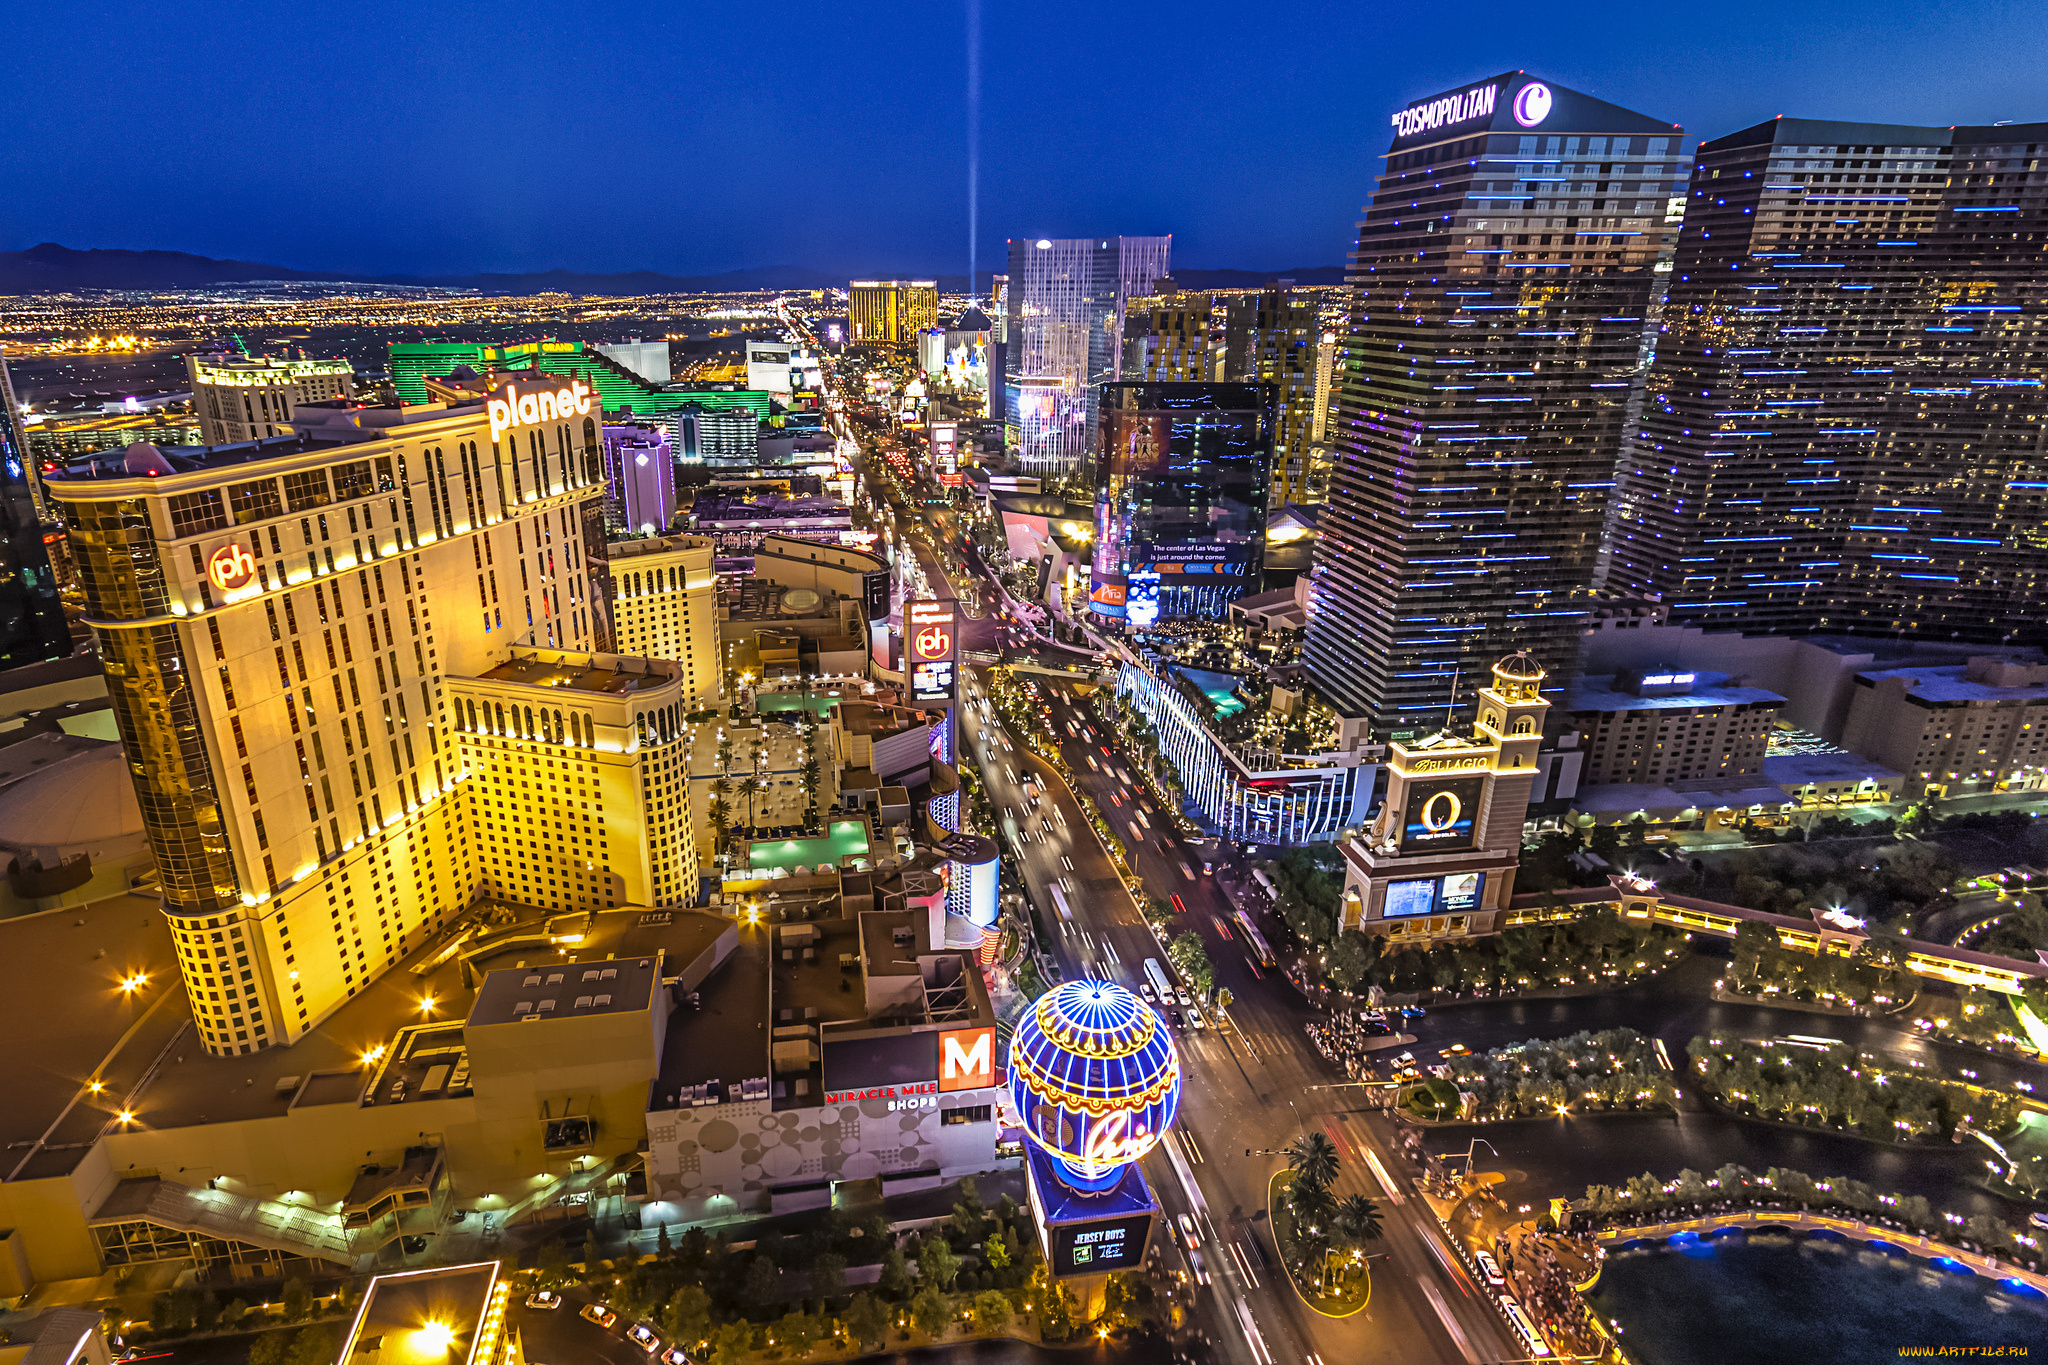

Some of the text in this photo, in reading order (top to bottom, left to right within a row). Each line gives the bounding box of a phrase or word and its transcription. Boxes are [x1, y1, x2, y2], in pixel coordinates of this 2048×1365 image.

[1391, 84, 1497, 137] THE COSMOPOLITAN
[542, 343, 575, 352] GRAND
[487, 380, 591, 443] planet
[213, 544, 254, 588] ph
[920, 627, 950, 654] ph
[1410, 757, 1487, 773] BELLAGIO
[1421, 790, 1461, 831] O
[945, 1033, 990, 1078] M
[826, 1083, 936, 1103] MIRACLE MILE
[888, 1097, 937, 1112] SHOPS
[1074, 1228, 1126, 1245] JERSEY BOYS
